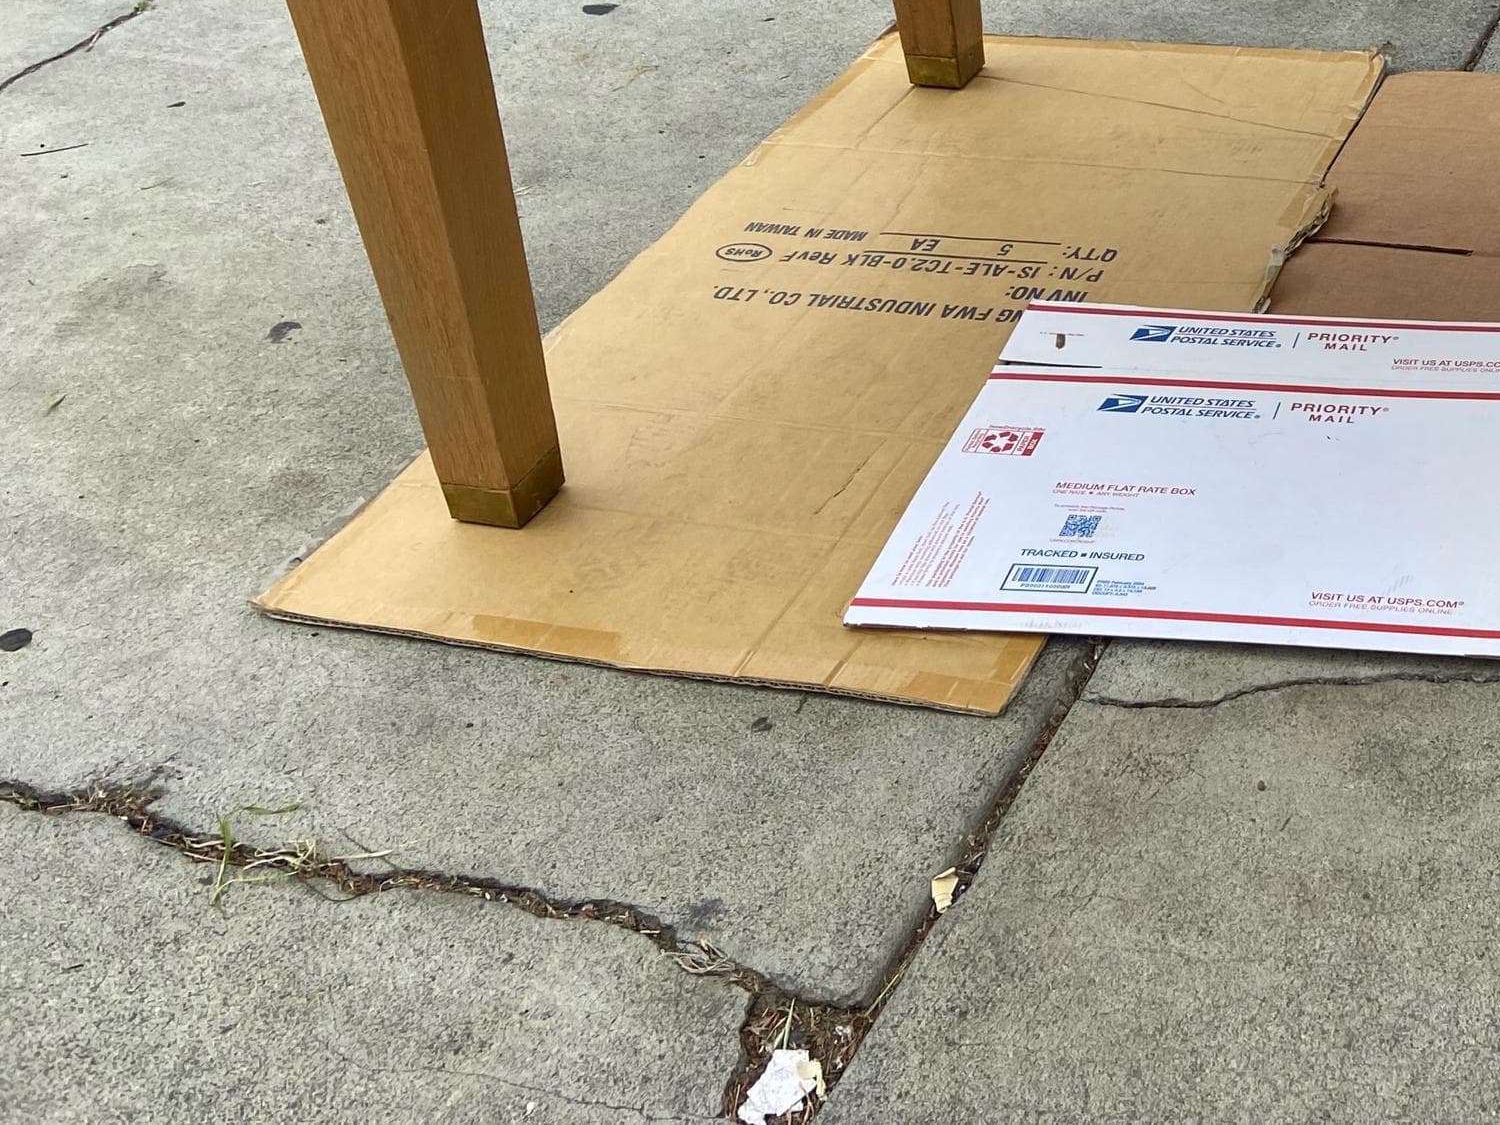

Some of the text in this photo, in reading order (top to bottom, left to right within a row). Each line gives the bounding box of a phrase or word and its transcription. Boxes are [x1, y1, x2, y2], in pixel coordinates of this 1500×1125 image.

[744, 222, 868, 241] MADE IN TAIWAN
[910, 238, 941, 252] EA
[997, 243, 1013, 256] 5
[725, 248, 764, 259] RoHS
[1047, 289, 1088, 303] INV
[807, 293, 937, 317] INDUSTRIAL
[941, 305, 994, 321] FWA
[1178, 326, 1277, 337] UNITED STATES
[1170, 336, 1219, 345] POSTAL
[1324, 342, 1368, 352] MAIL
[1393, 358, 1419, 367] VISIT
[1421, 359, 1438, 367] US
[1150, 395, 1256, 408] UNITED STATES
[1141, 406, 1195, 417] POSTAL
[1308, 414, 1355, 424] MAIL
[1055, 482, 1197, 496] MEDIUM FLAT RATE BOX
[1020, 548, 1145, 562] TRACKED INSURED
[1311, 591, 1344, 601] VISIT
[1346, 594, 1366, 603] US
[1367, 595, 1385, 604] AT
